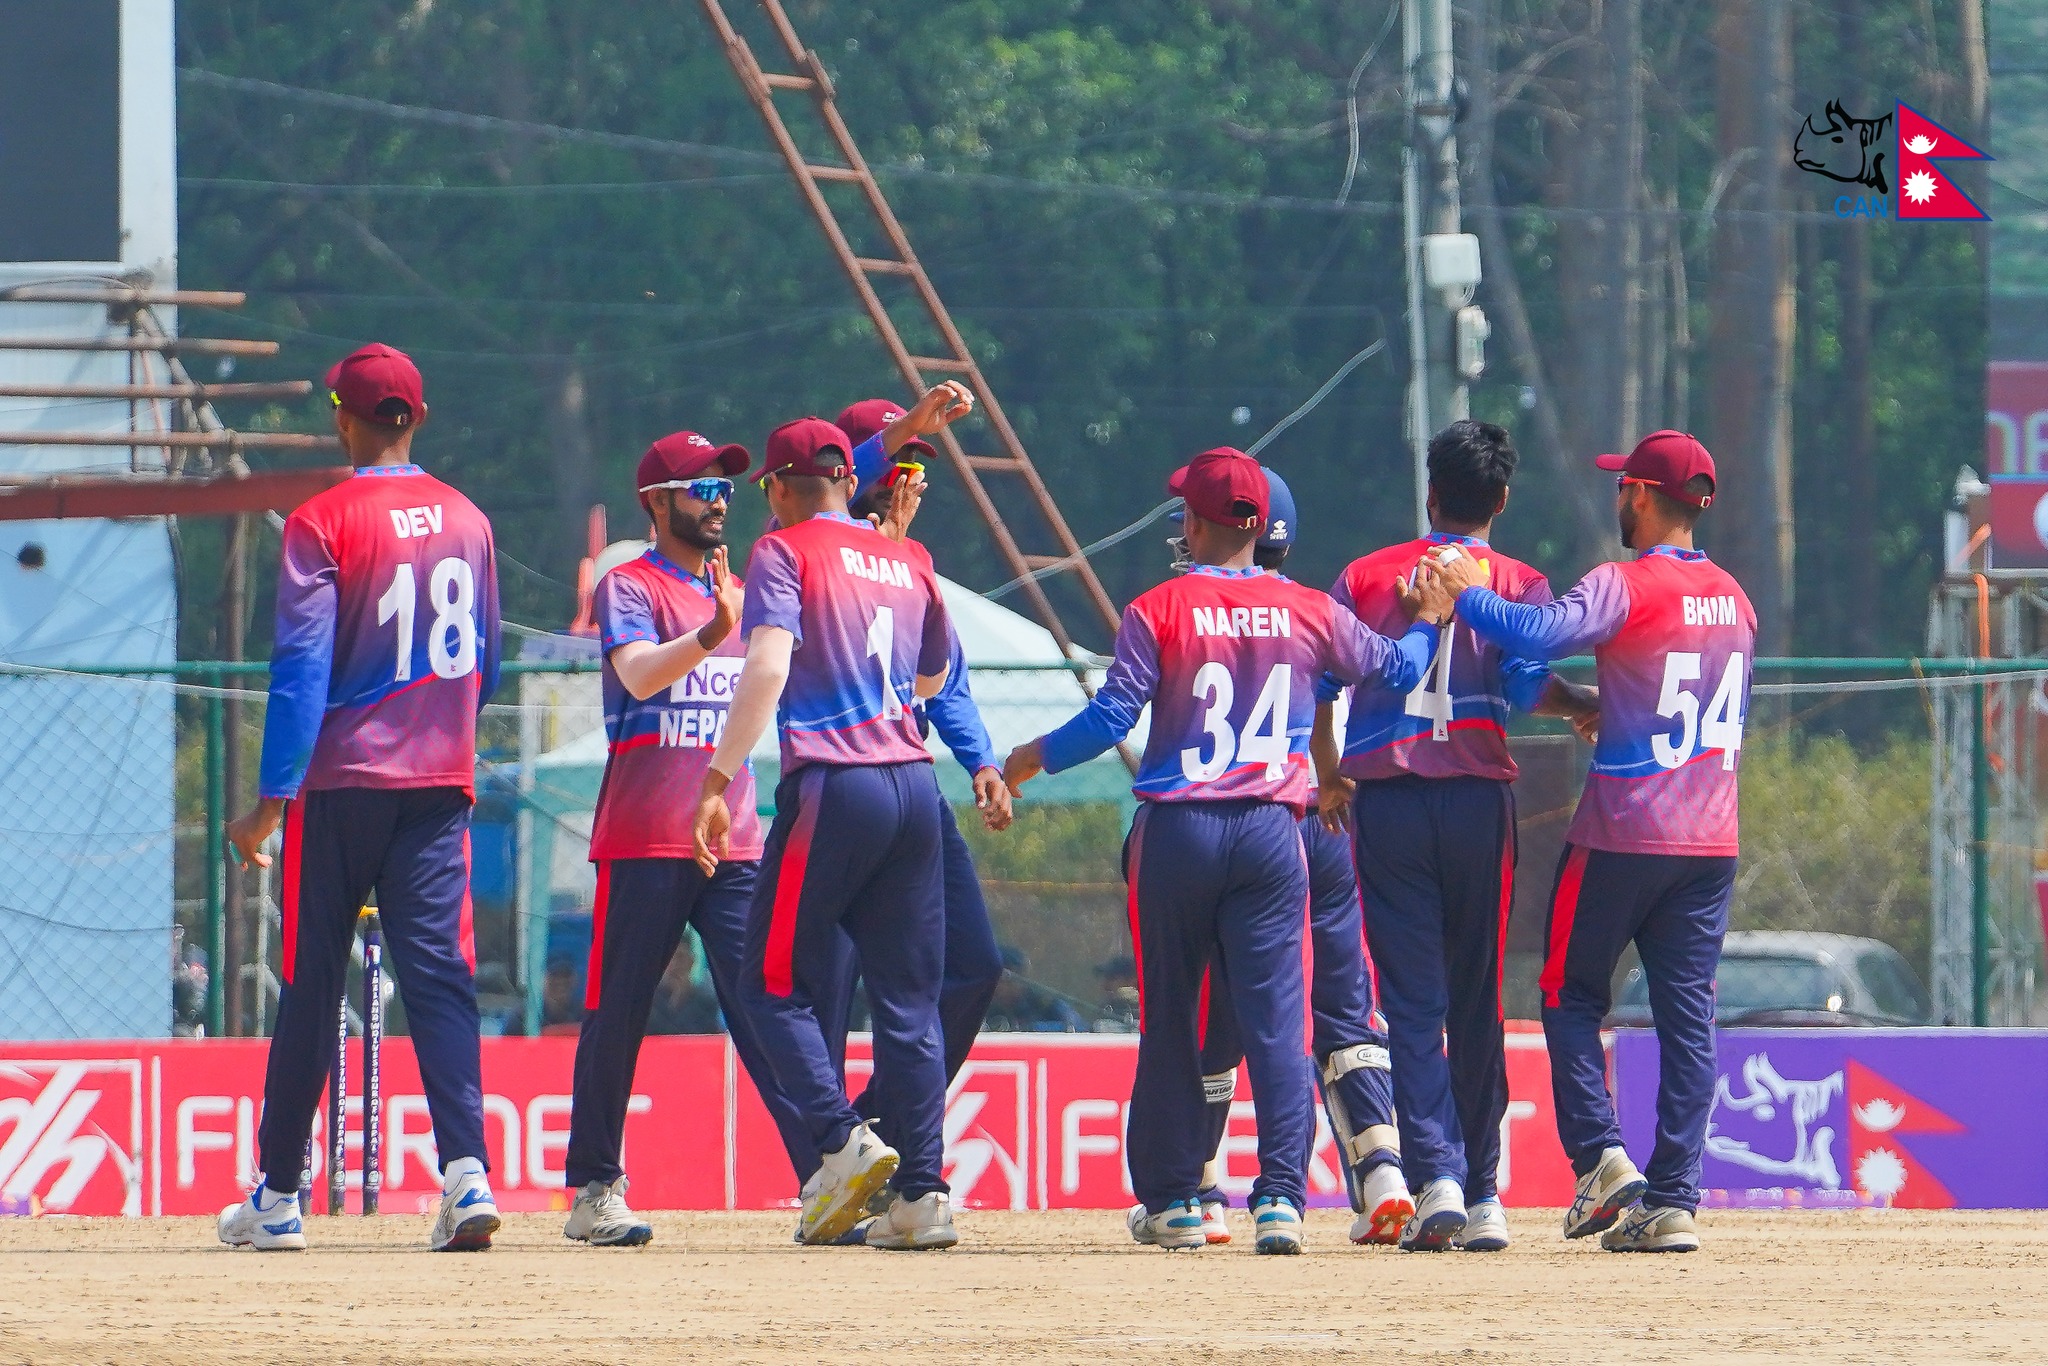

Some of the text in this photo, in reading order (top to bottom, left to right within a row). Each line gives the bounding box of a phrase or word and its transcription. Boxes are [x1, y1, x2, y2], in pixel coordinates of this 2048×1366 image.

[389, 504, 443, 539] DEV
[839, 547, 914, 590] RIJAN
[377, 556, 477, 682] 18
[1193, 607, 1291, 638] NAREN
[1683, 595, 1737, 626] BHIM
[685, 664, 742, 696] Nce
[867, 606, 903, 721] 1
[1404, 621, 1454, 742] 4
[659, 709, 728, 748] NEP
[1181, 662, 1292, 783] 34
[1651, 651, 1744, 771] 54
